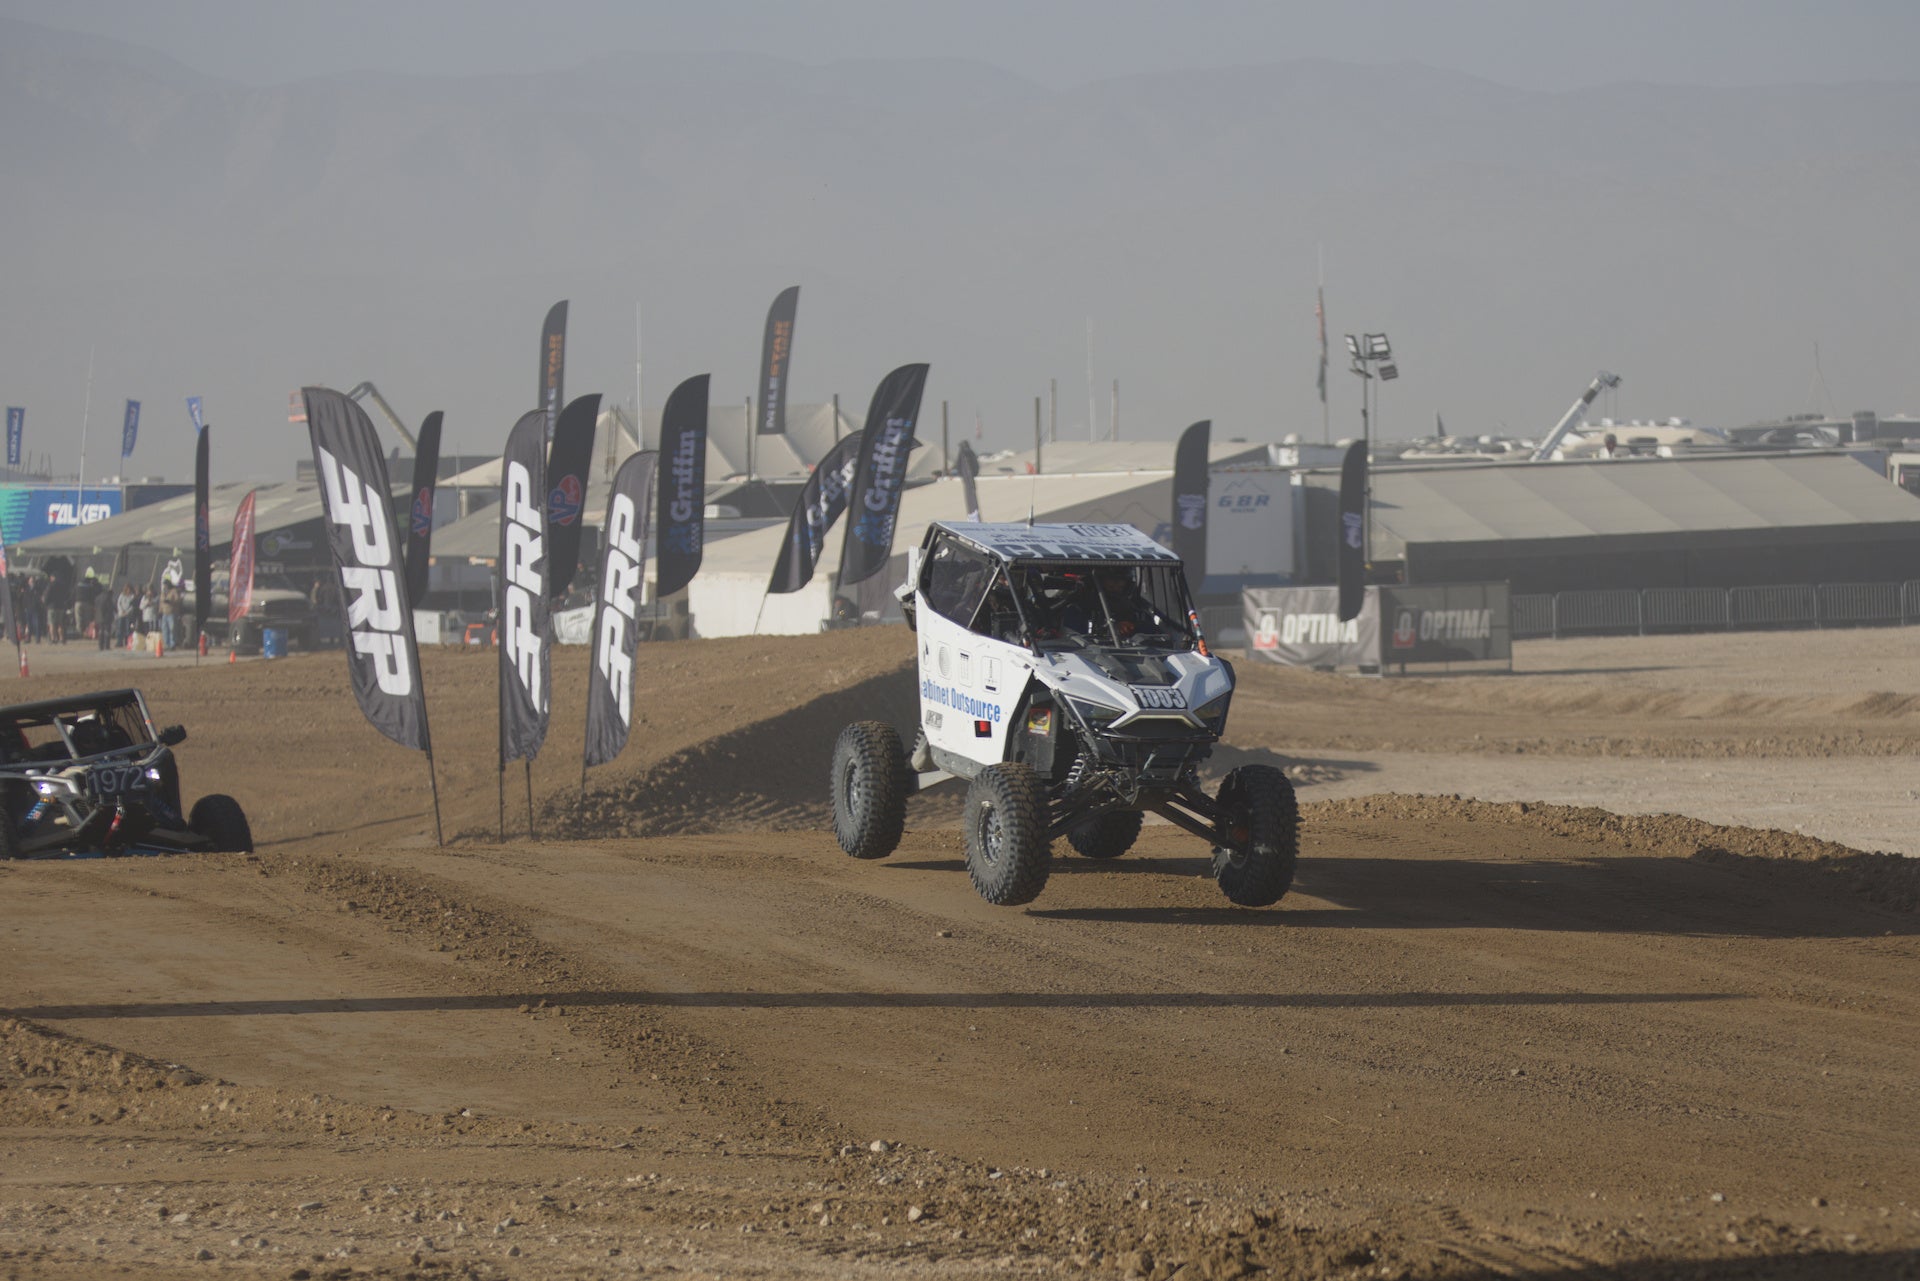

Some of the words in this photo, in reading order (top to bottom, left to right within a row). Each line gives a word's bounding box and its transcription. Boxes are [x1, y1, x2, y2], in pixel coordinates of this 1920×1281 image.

[670, 430, 696, 522] Griffin
[863, 417, 904, 512] Griffin
[47, 502, 111, 525] FALKEN
[1070, 525, 1129, 537] 1003
[991, 543, 1177, 561] CLARK
[318, 445, 412, 696] PRP
[505, 460, 543, 715] PRP
[599, 492, 641, 728] PRP
[1419, 609, 1491, 641] OPTIMA
[1282, 613, 1359, 645] OPTIMA
[951, 687, 1001, 723] Outsource
[1132, 689, 1186, 709] 1003
[88, 766, 146, 794] 1972
